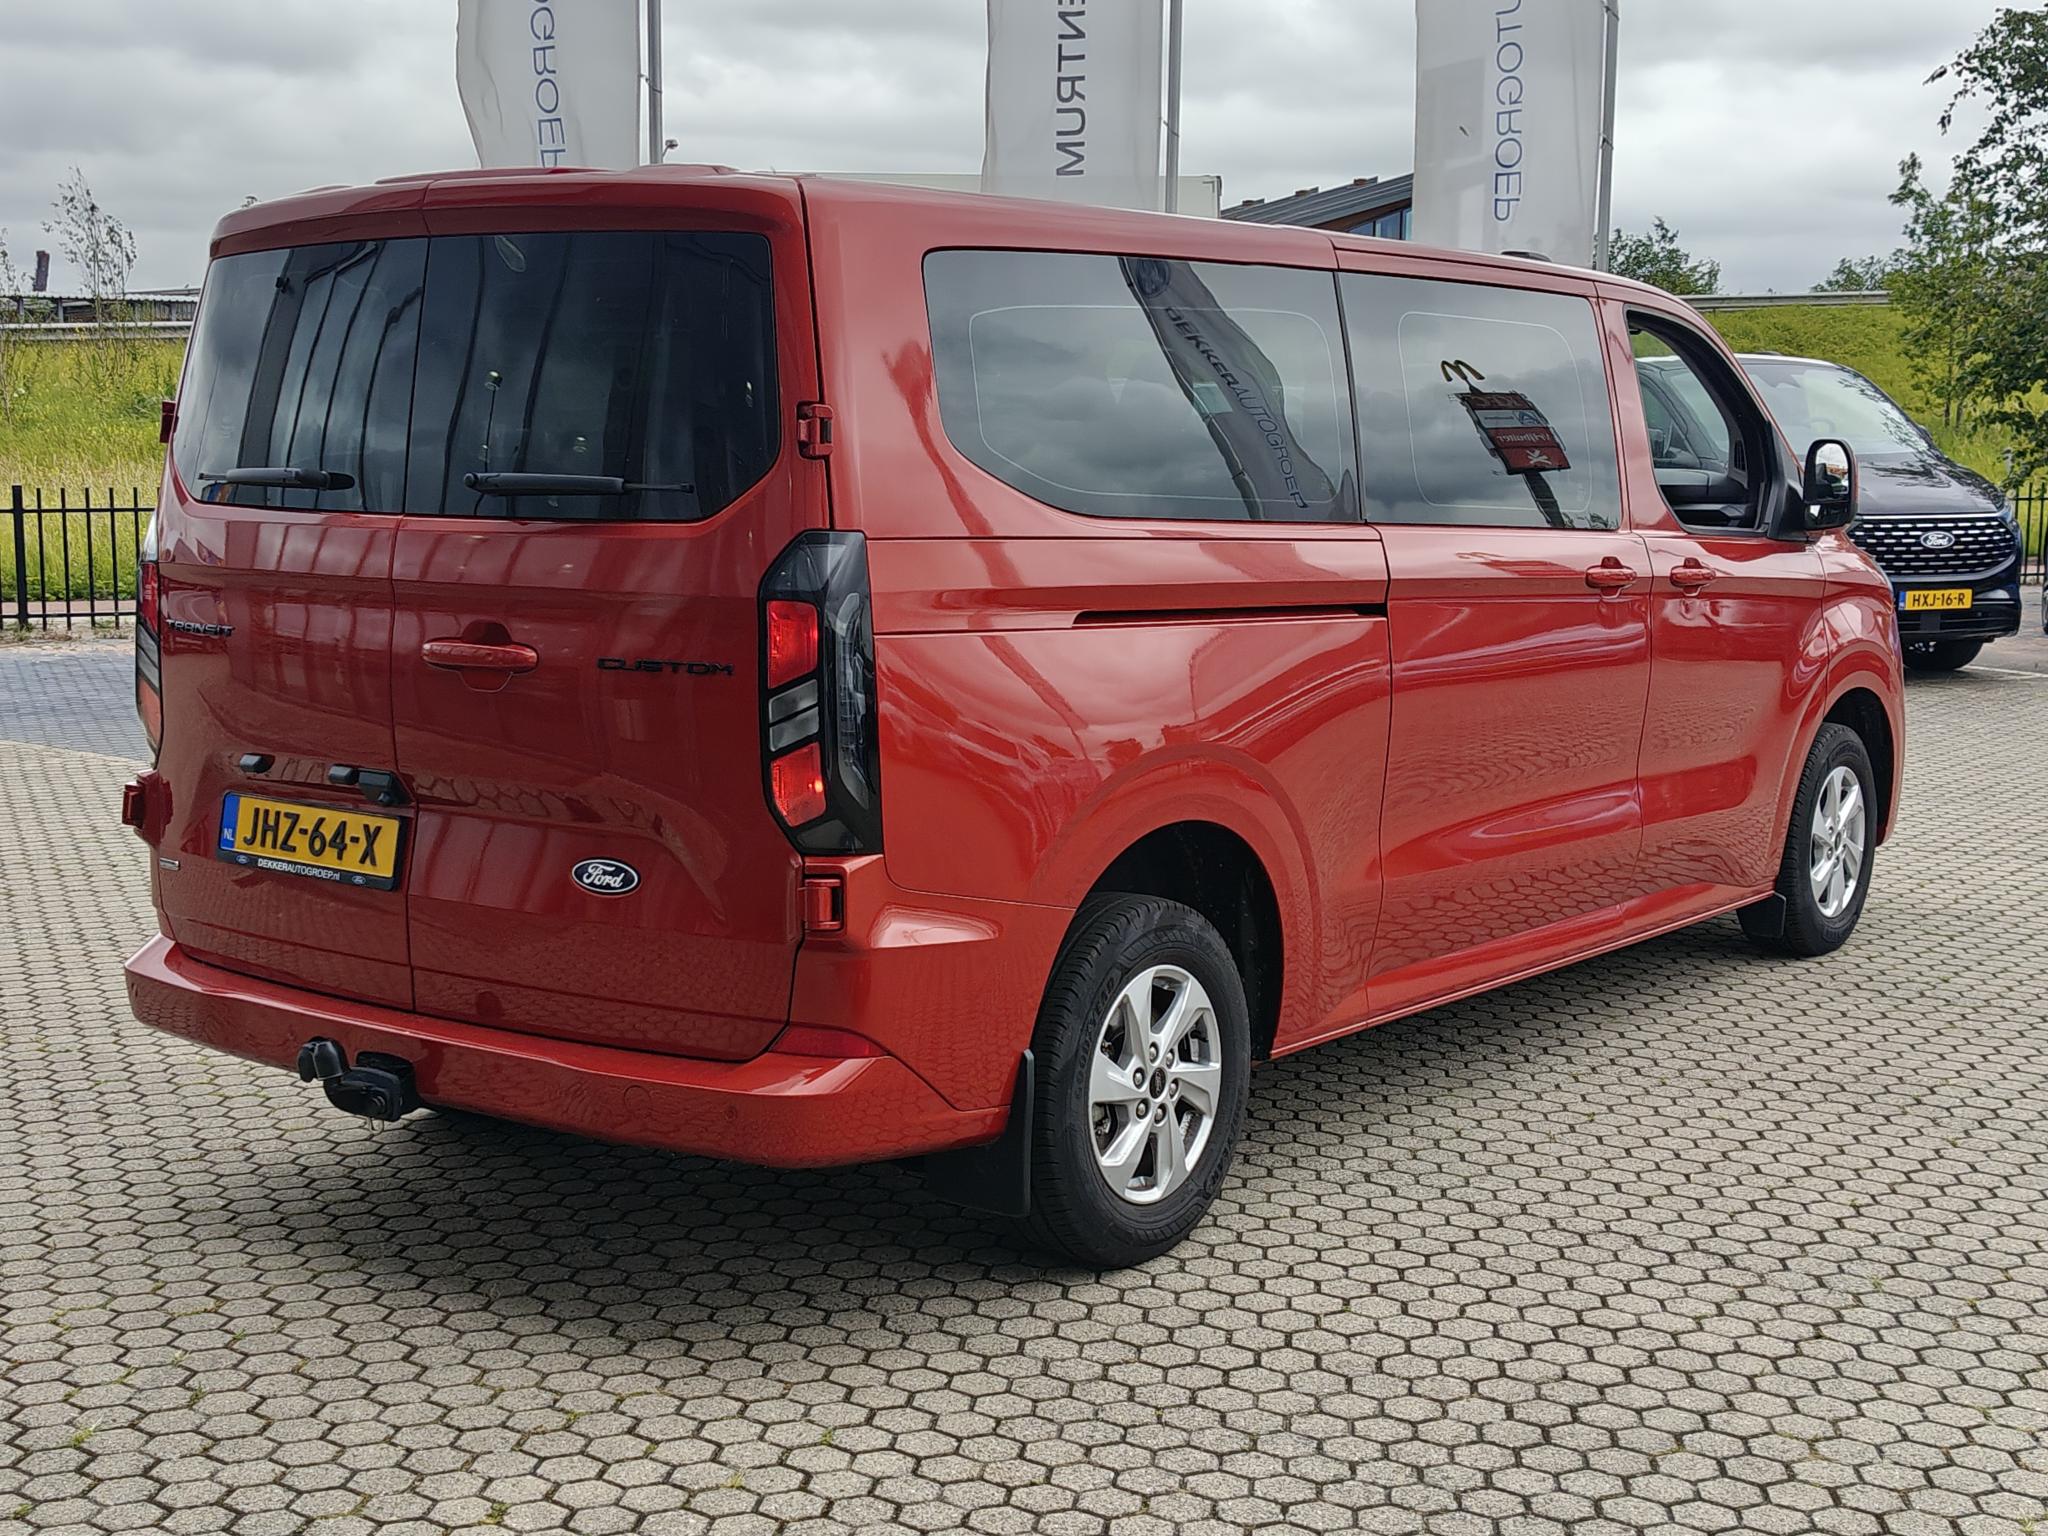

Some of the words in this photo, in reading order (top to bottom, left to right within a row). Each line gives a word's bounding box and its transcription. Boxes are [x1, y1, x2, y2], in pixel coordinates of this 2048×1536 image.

[1926, 533, 1950, 546] Ford
[1912, 592, 1966, 607] HXJ-16-R
[165, 618, 236, 637] TRANSIT
[596, 656, 735, 676] CUSTOM
[223, 827, 235, 841] NL
[242, 806, 383, 867] JHZ-64-X
[582, 863, 626, 888] Ford
